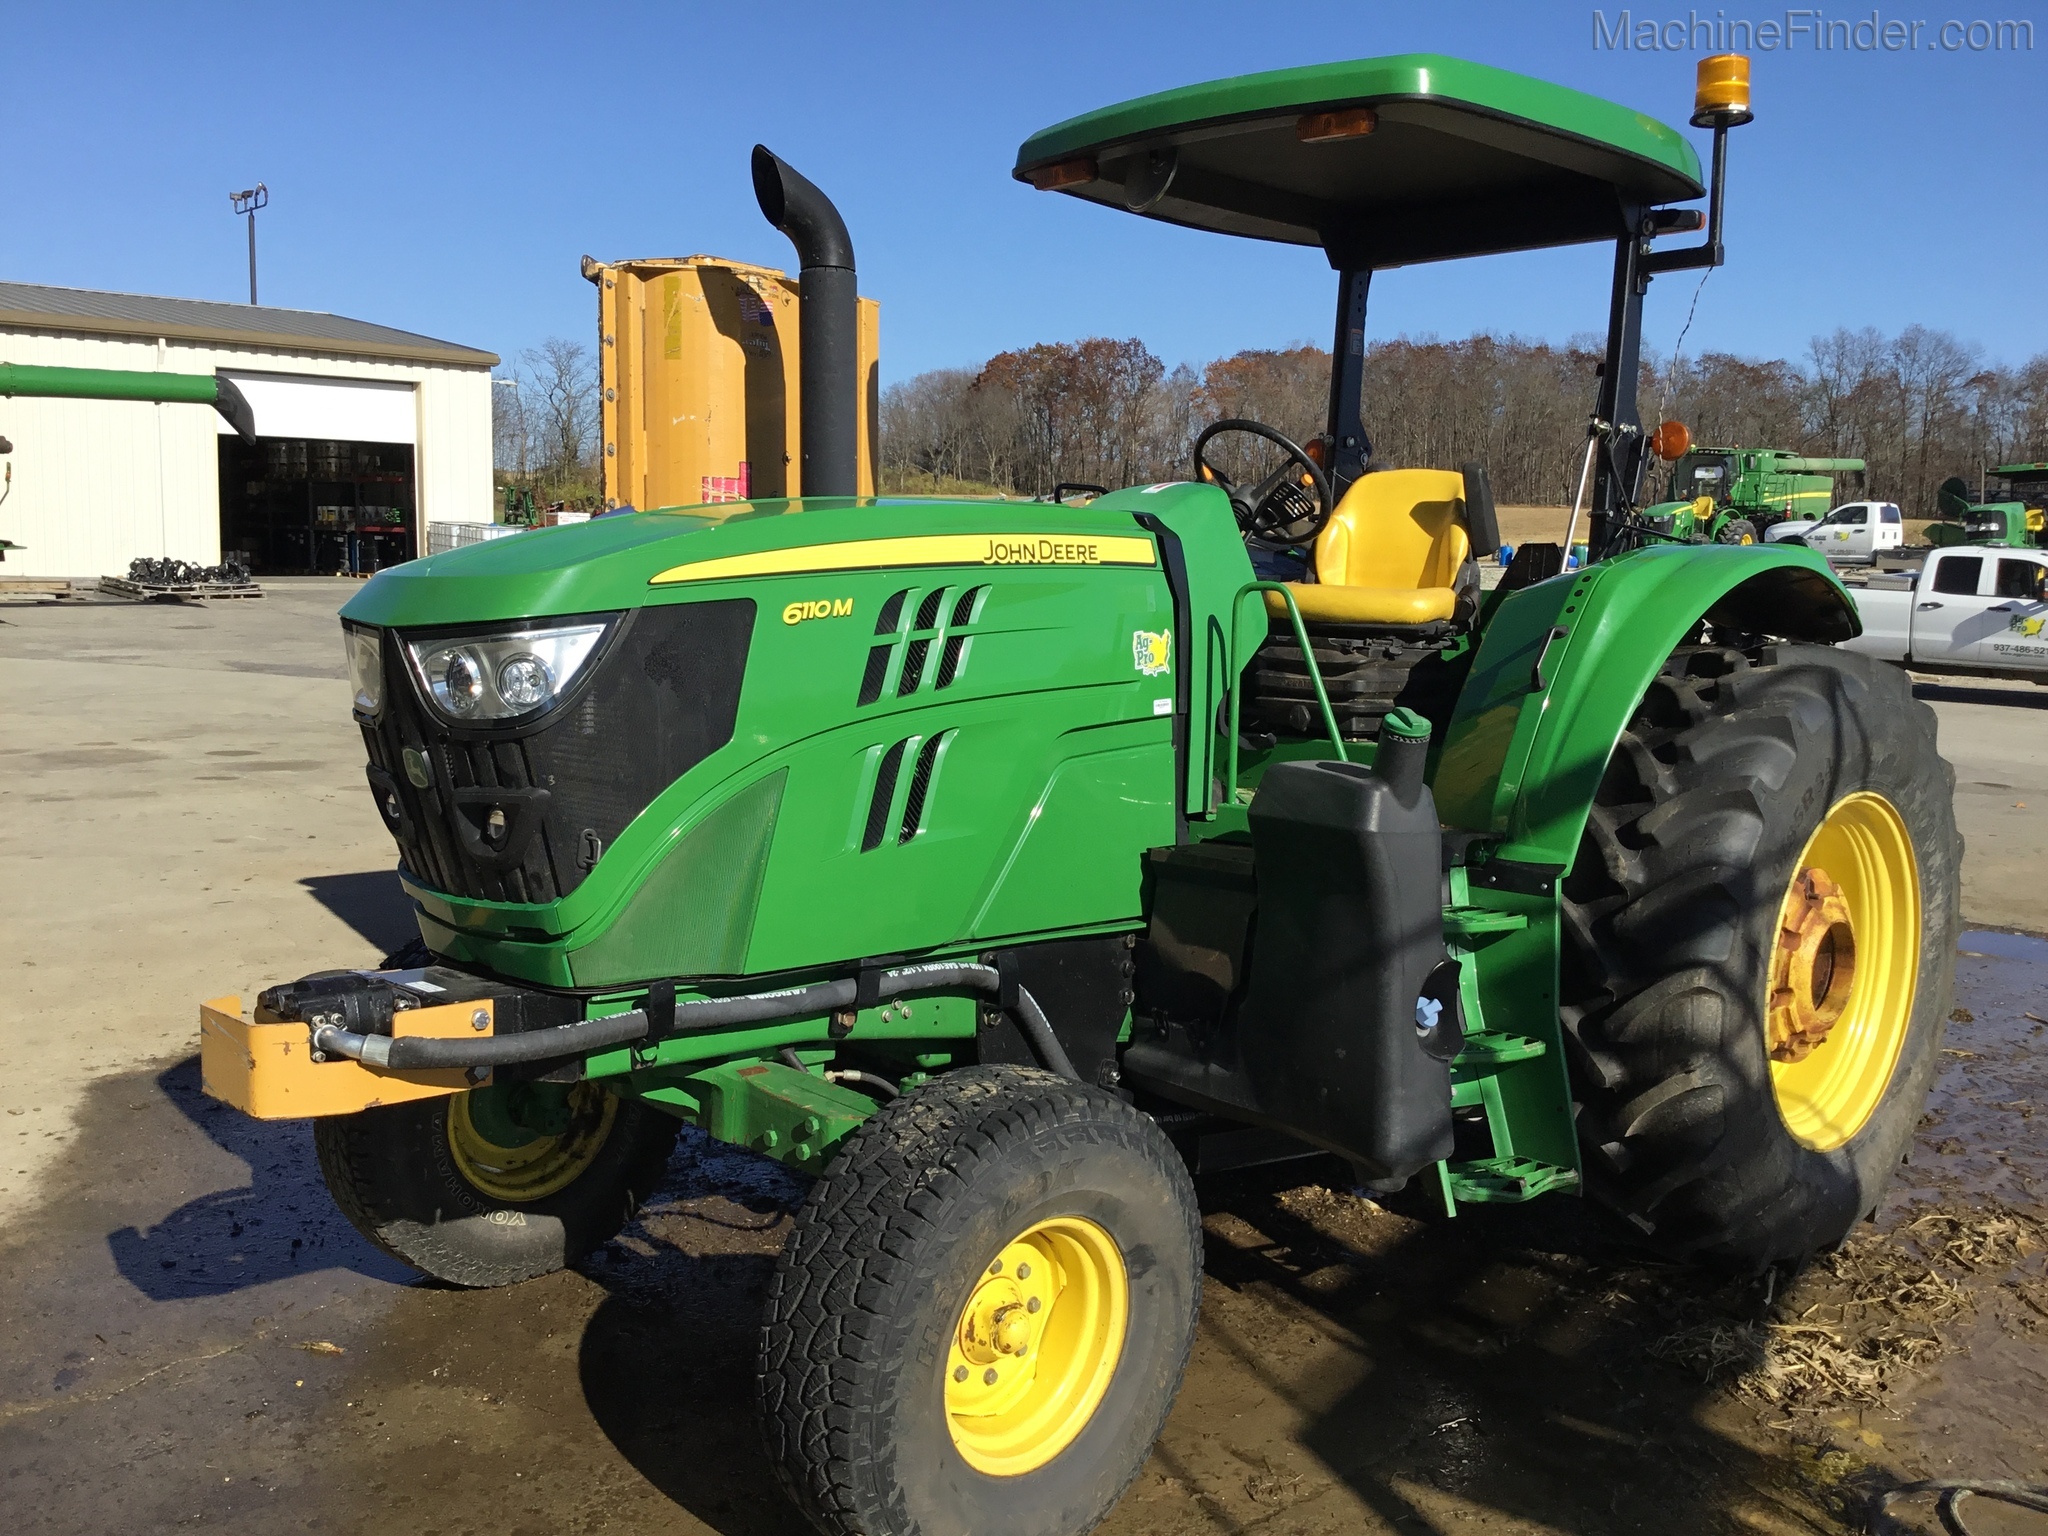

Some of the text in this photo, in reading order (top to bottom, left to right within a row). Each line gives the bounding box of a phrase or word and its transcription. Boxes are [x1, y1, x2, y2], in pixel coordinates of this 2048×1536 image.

[983, 539, 1098, 561] JOHN DEERE
[1136, 650, 1154, 667] Pro
[431, 1111, 527, 1227] YOKOHAMA
